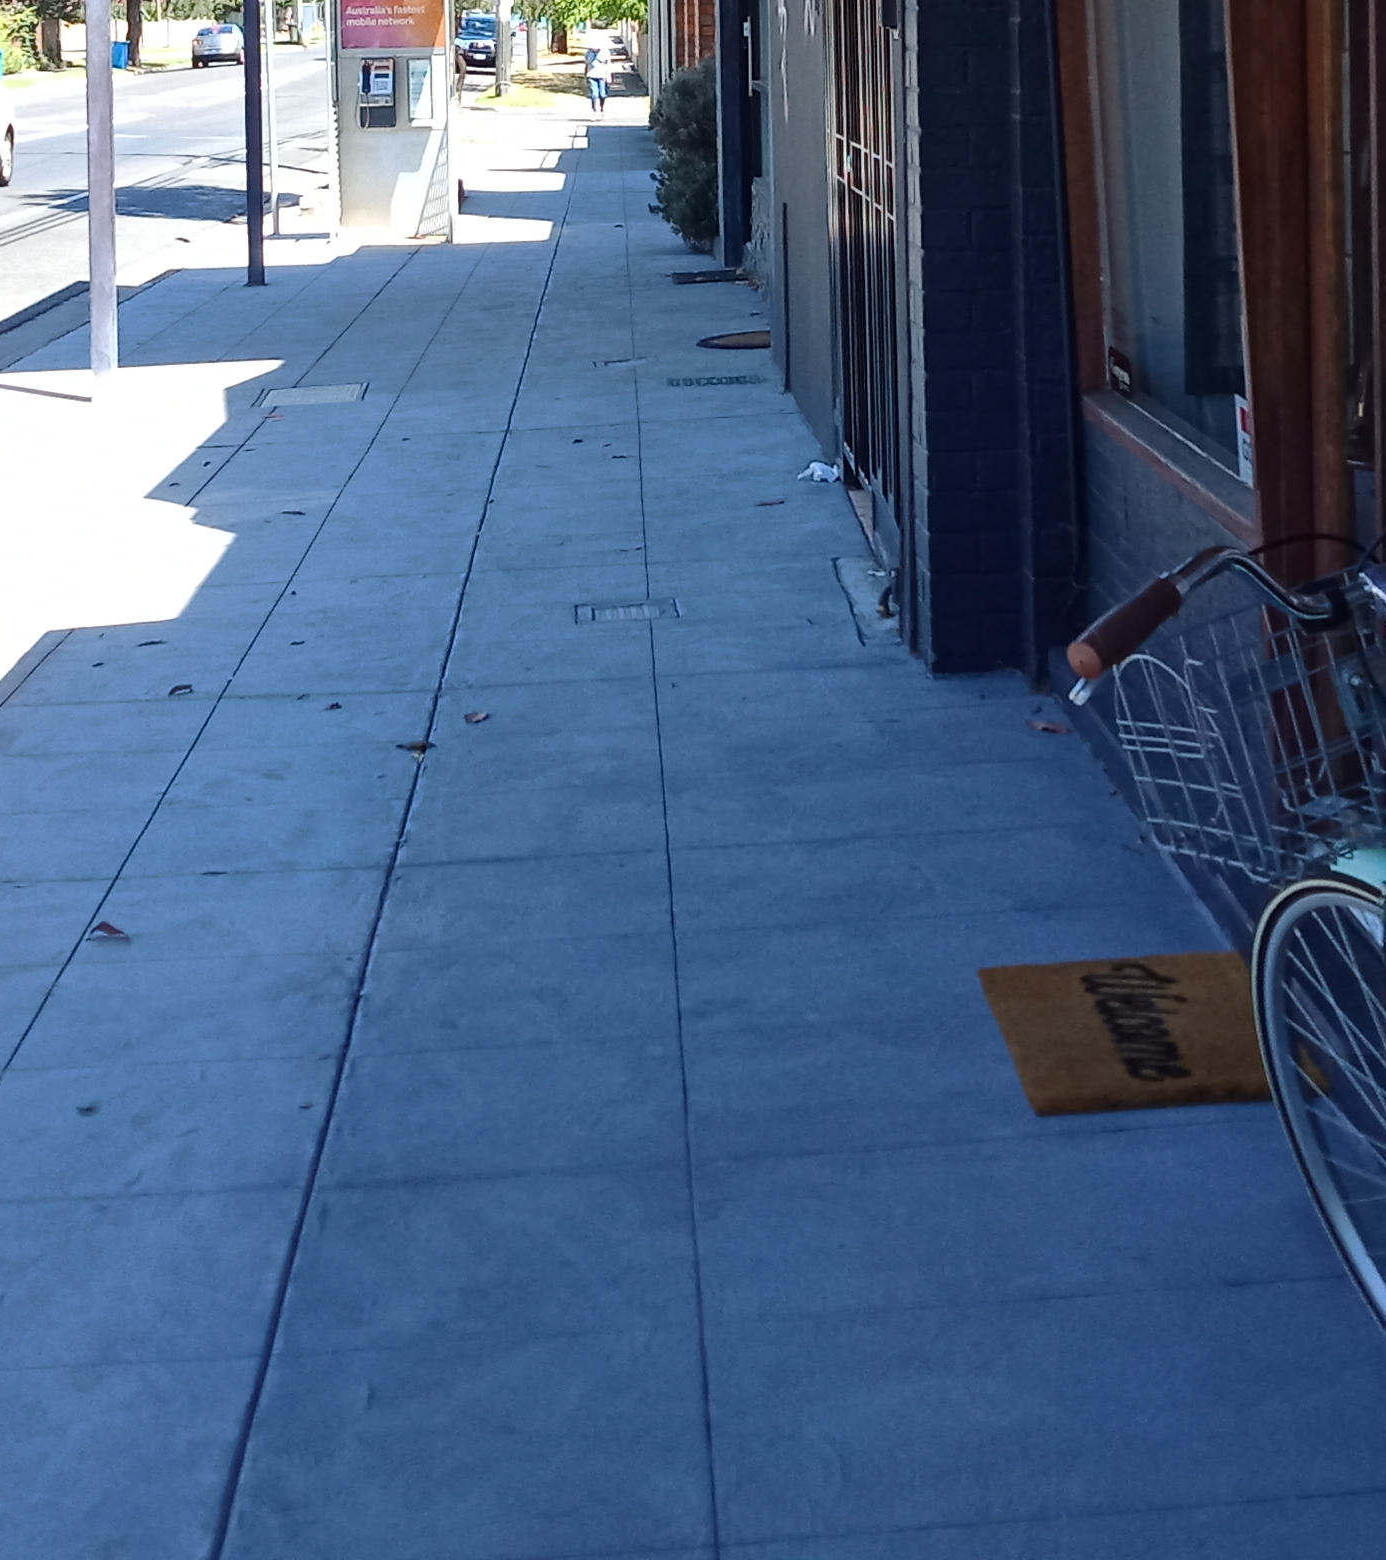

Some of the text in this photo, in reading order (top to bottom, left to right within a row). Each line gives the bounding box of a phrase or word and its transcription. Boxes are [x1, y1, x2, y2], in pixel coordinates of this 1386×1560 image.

[345, 3, 426, 16] Australia's fastest
[346, 16, 415, 27] mobile network
